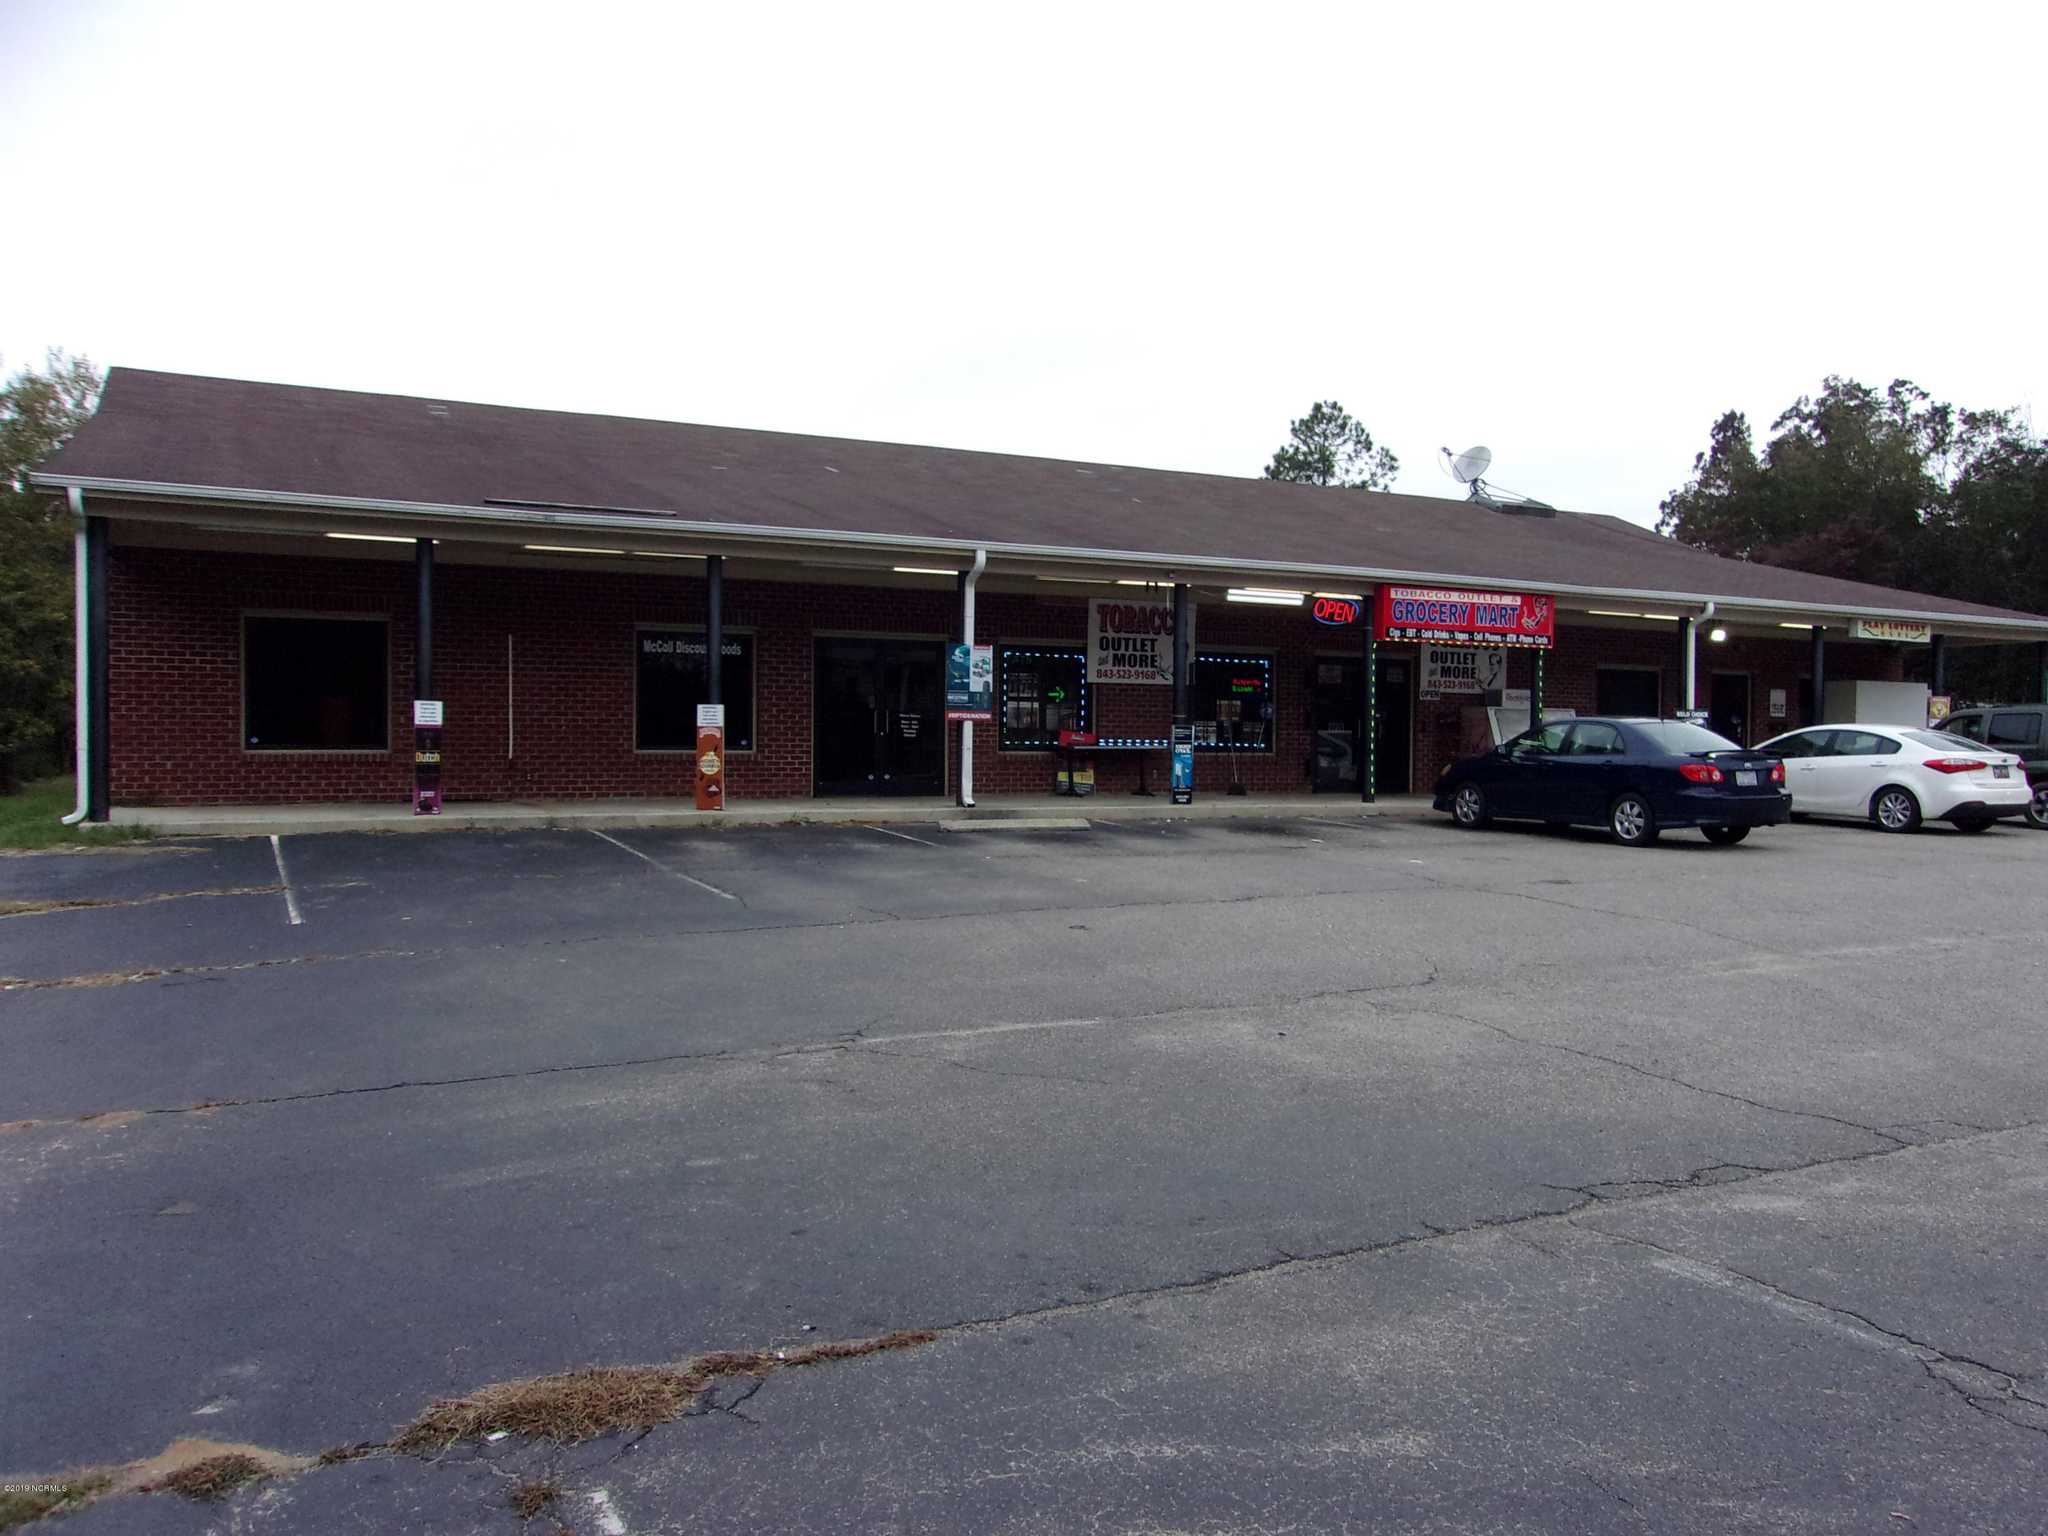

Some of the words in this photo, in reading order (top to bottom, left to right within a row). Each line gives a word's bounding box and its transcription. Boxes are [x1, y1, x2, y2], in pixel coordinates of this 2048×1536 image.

[1394, 590, 1452, 600] TOBACCO
[1458, 593, 1504, 603] OUTLET
[1313, 598, 1356, 624] OPEN
[1393, 600, 1471, 625] GROCERY
[1475, 604, 1519, 628] MART
[1097, 604, 1175, 635] TOBACC
[1863, 621, 1885, 629] PLAY
[1888, 623, 1927, 632] LOTTERY
[720, 643, 742, 655] oods
[1099, 636, 1158, 652] OUTLET
[1112, 653, 1158, 668] MORE
[1430, 650, 1477, 665] OUTLET
[1440, 666, 1477, 679] MORE
